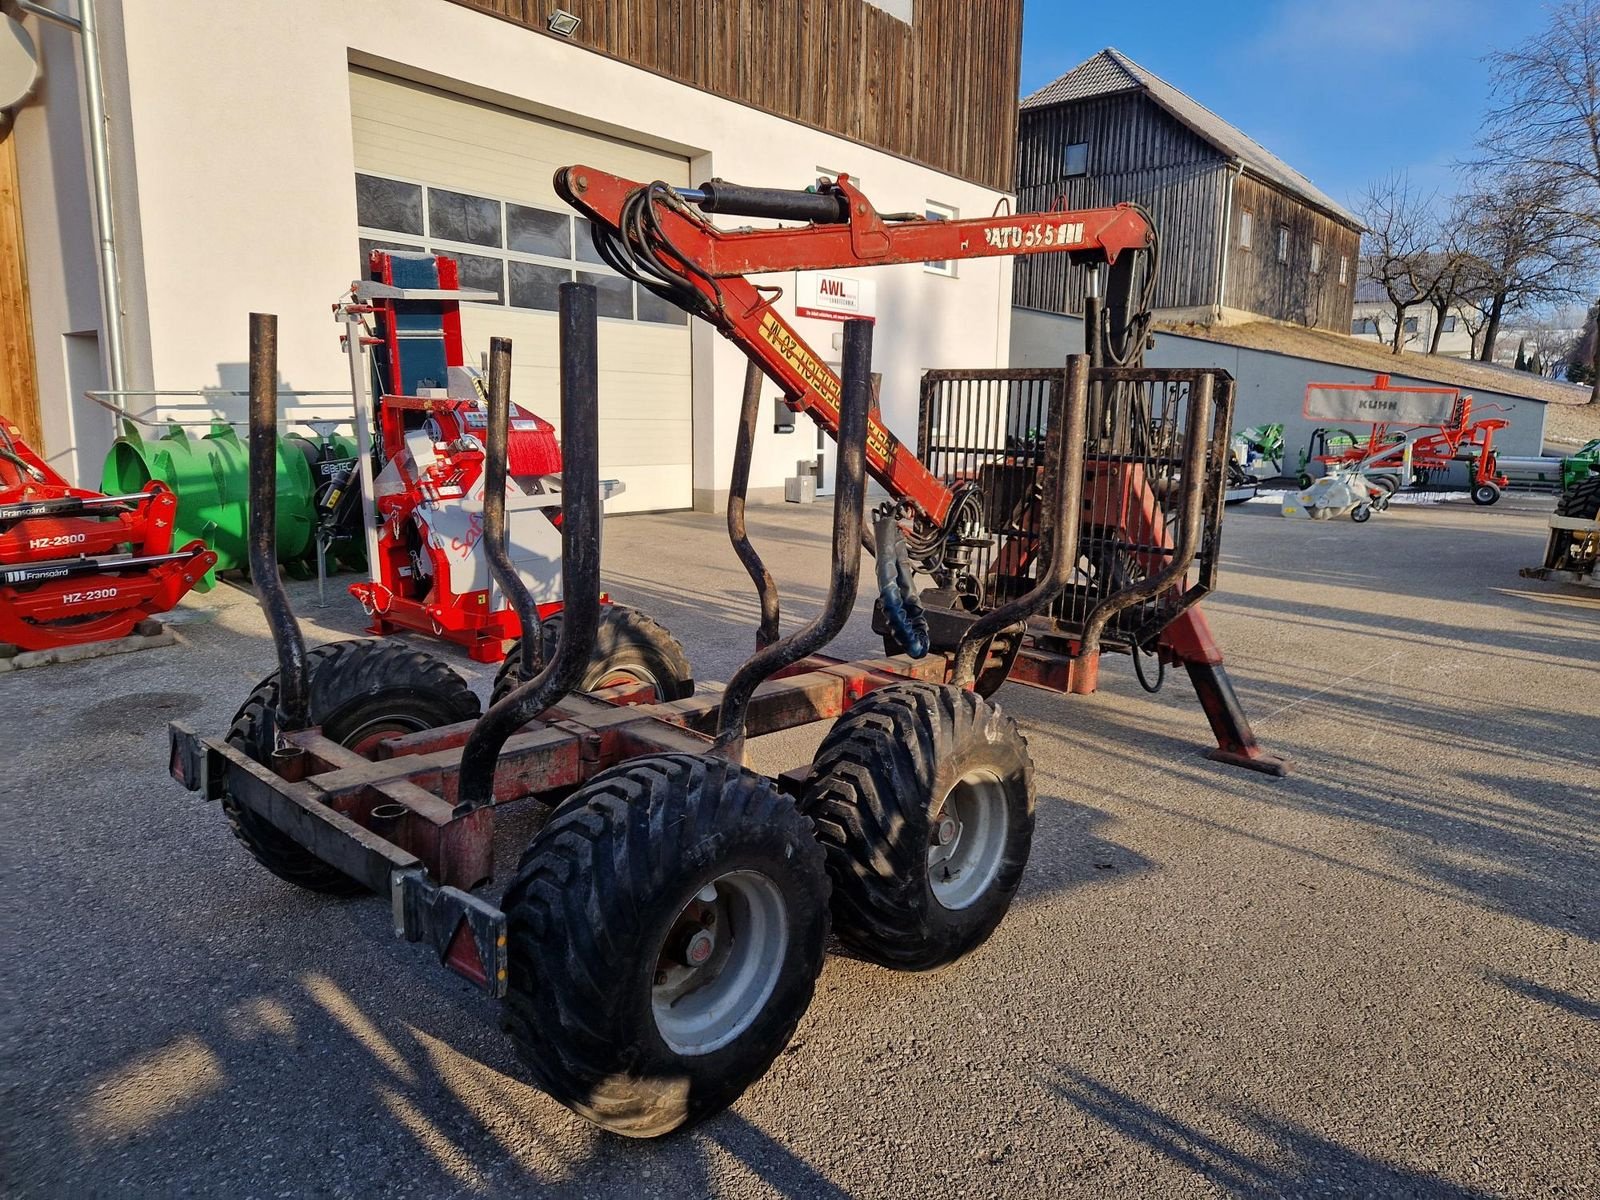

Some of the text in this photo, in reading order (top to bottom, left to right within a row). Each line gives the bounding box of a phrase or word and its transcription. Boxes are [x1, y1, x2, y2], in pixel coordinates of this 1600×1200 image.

[820, 278, 846, 298] AWL
[1358, 400, 1398, 410] KUHN
[29, 533, 86, 549] HZ-2300
[26, 569, 69, 581] Fransgård
[63, 588, 117, 604] HZ-2300
